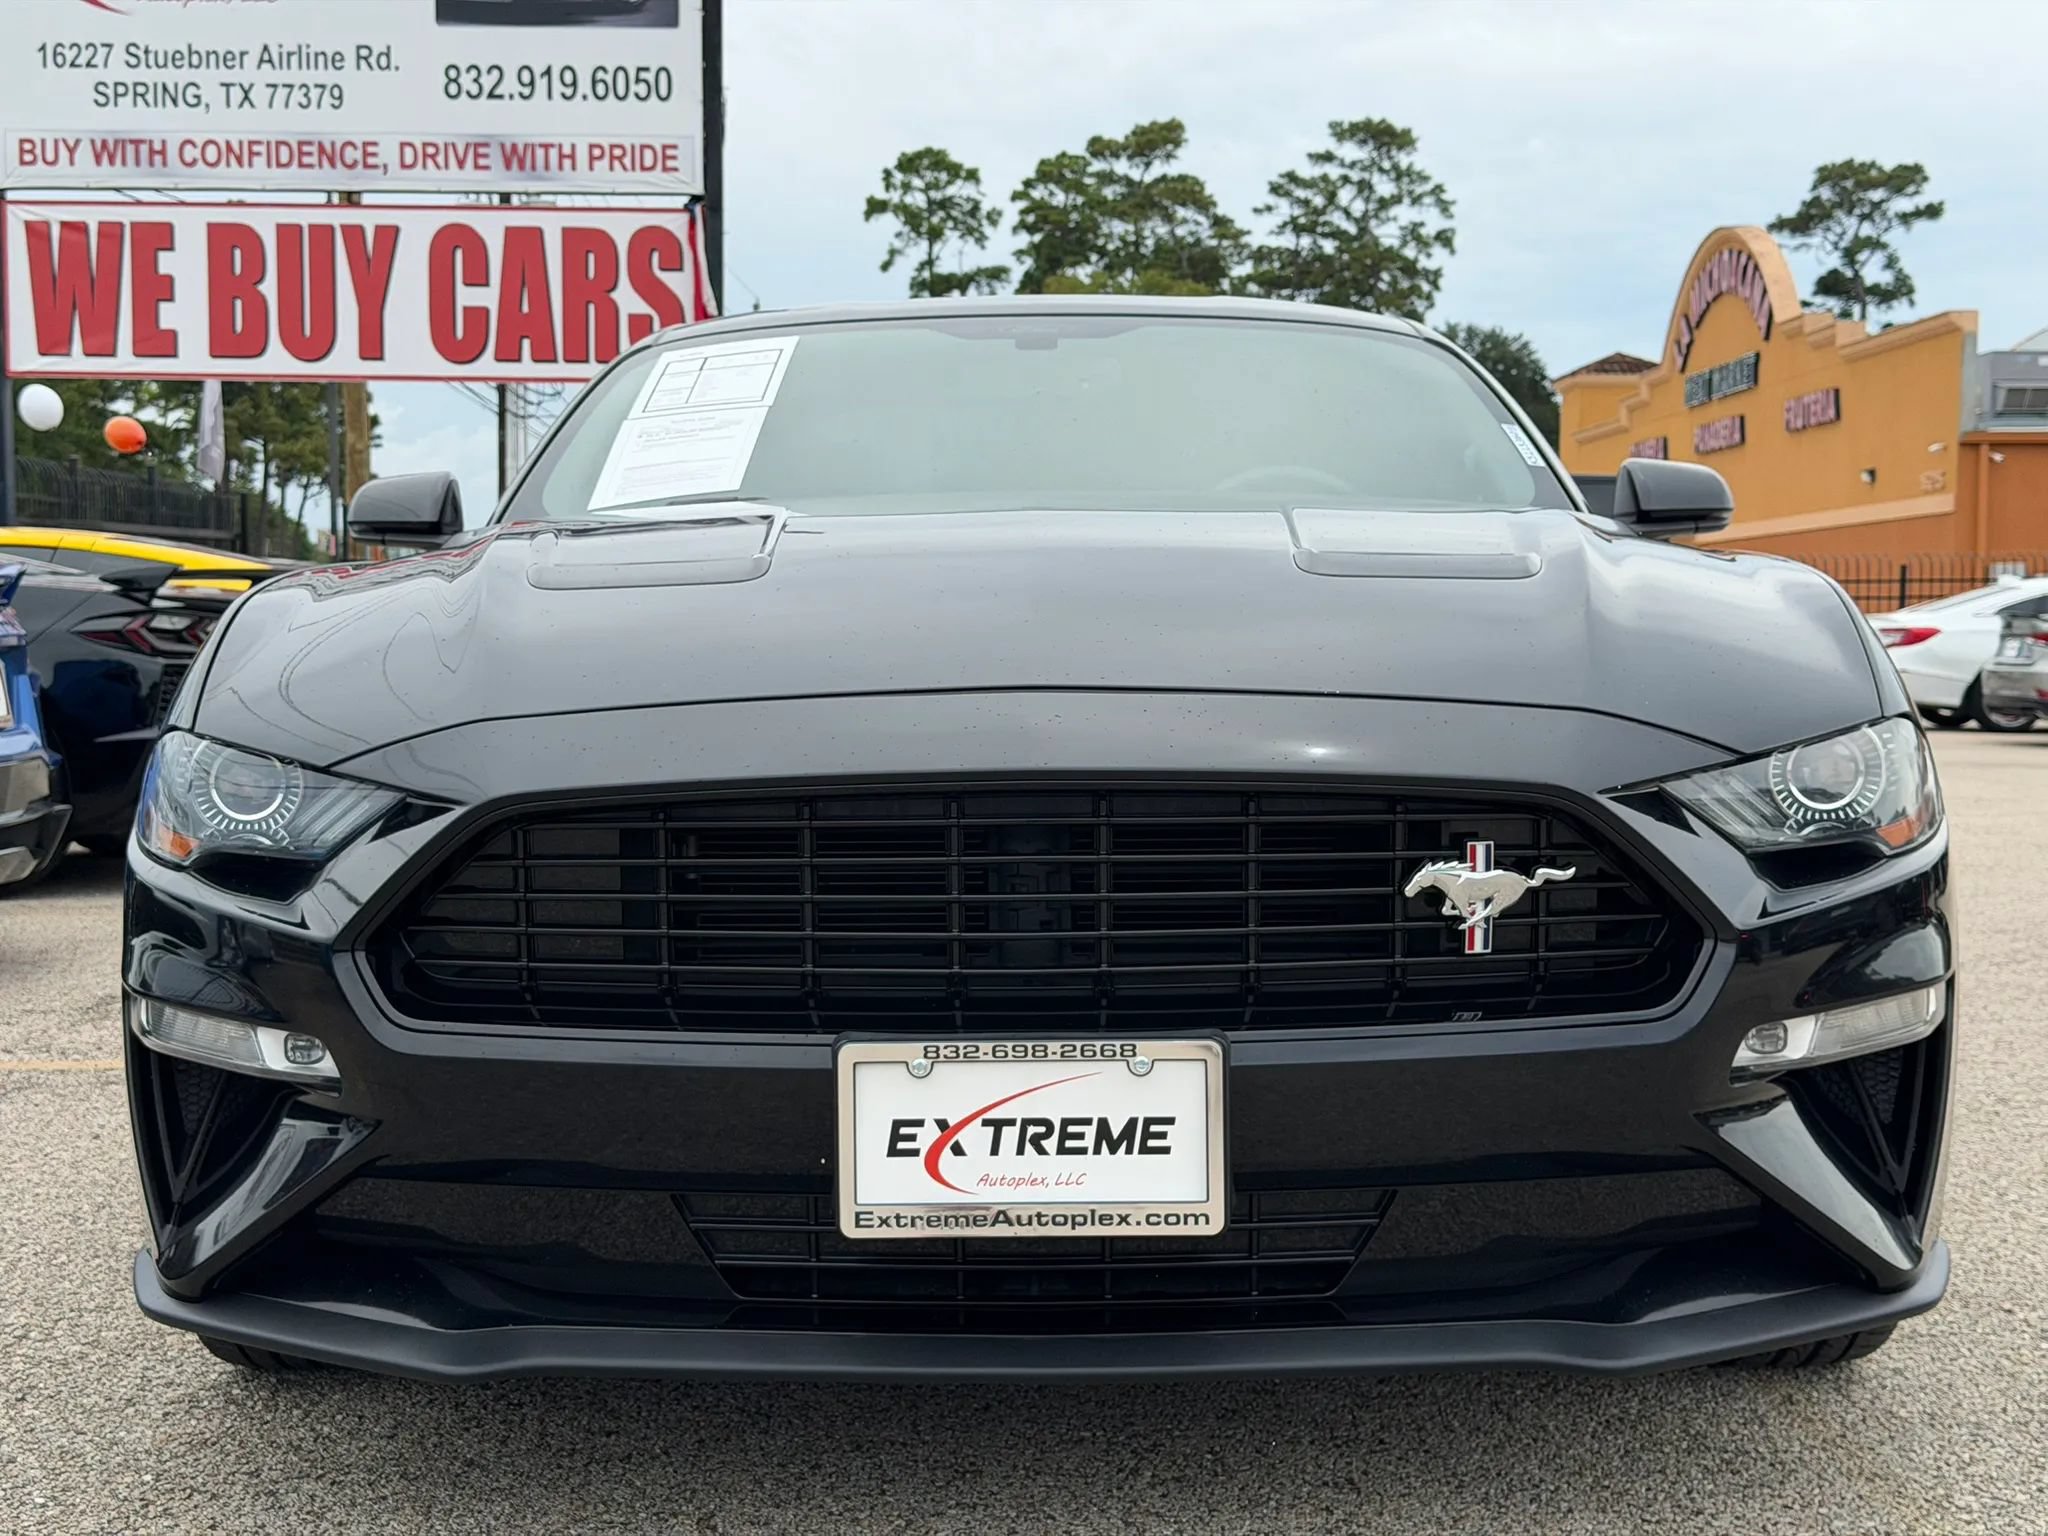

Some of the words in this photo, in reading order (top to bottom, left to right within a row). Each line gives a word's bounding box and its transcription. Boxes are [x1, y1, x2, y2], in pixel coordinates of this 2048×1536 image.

[37, 42, 114, 69] 16227
[124, 42, 250, 70] Stuebner
[256, 44, 346, 71] Airline
[355, 47, 400, 72] Rd.
[93, 82, 211, 113] SPRING,
[219, 83, 257, 109] TX
[264, 84, 345, 110] 77379
[443, 64, 673, 102] 832.919.6050
[18, 138, 82, 167] BUY
[90, 138, 168, 168] WITH
[178, 139, 389, 175] CONFIDENCE,
[399, 142, 491, 171] DRIVE
[499, 143, 577, 172] WITH
[587, 144, 680, 173] PRIDE
[24, 220, 178, 357] WE
[206, 222, 400, 361] BUY
[428, 223, 685, 363] CARS
[922, 1043, 1138, 1060] 832-698-2668
[885, 1115, 1178, 1159] EXTREME
[976, 1172, 1049, 1191] Autoplex,
[1055, 1172, 1088, 1186] LLC
[854, 1208, 1211, 1232] ExtremeAutoplex.com
